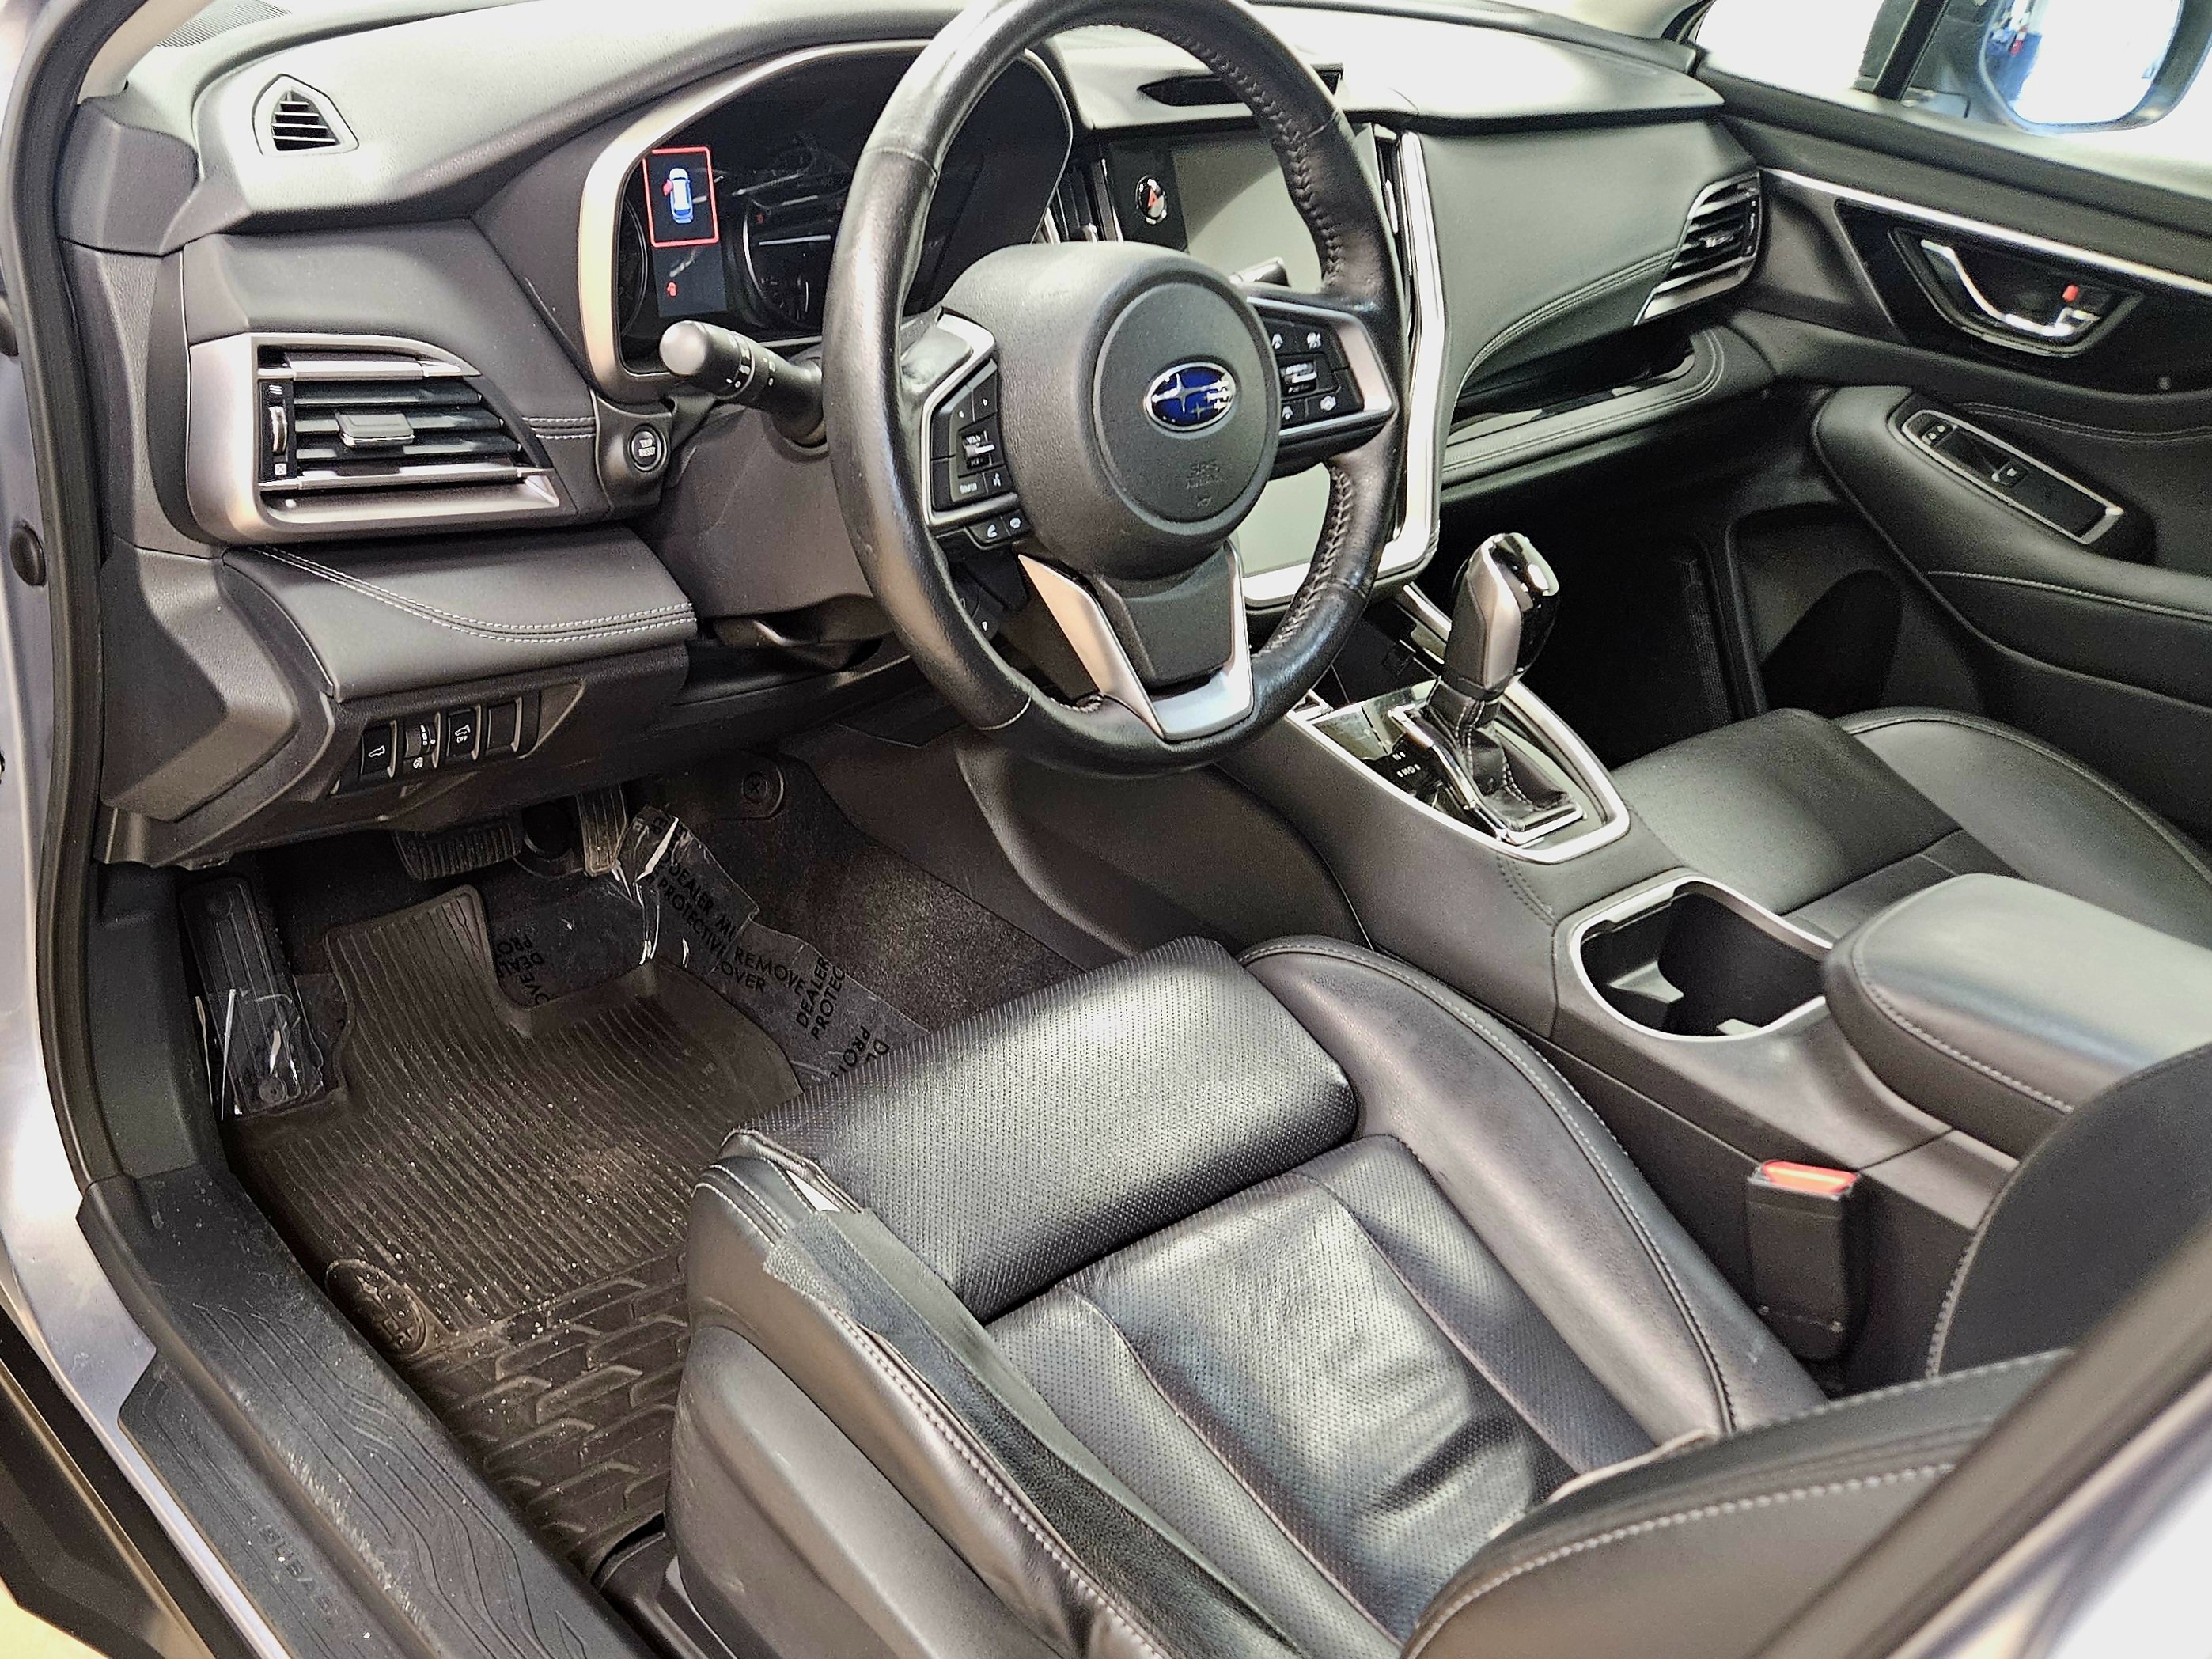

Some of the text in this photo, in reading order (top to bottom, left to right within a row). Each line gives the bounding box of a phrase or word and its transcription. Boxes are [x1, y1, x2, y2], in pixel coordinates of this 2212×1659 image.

[495, 934, 532, 955] PRO
[669, 864, 715, 915] DEALER
[734, 945, 805, 996] REMOVE
[718, 960, 766, 994] OVER
[796, 956, 830, 1028] DEALER
[811, 965, 846, 1040] PROTEC
